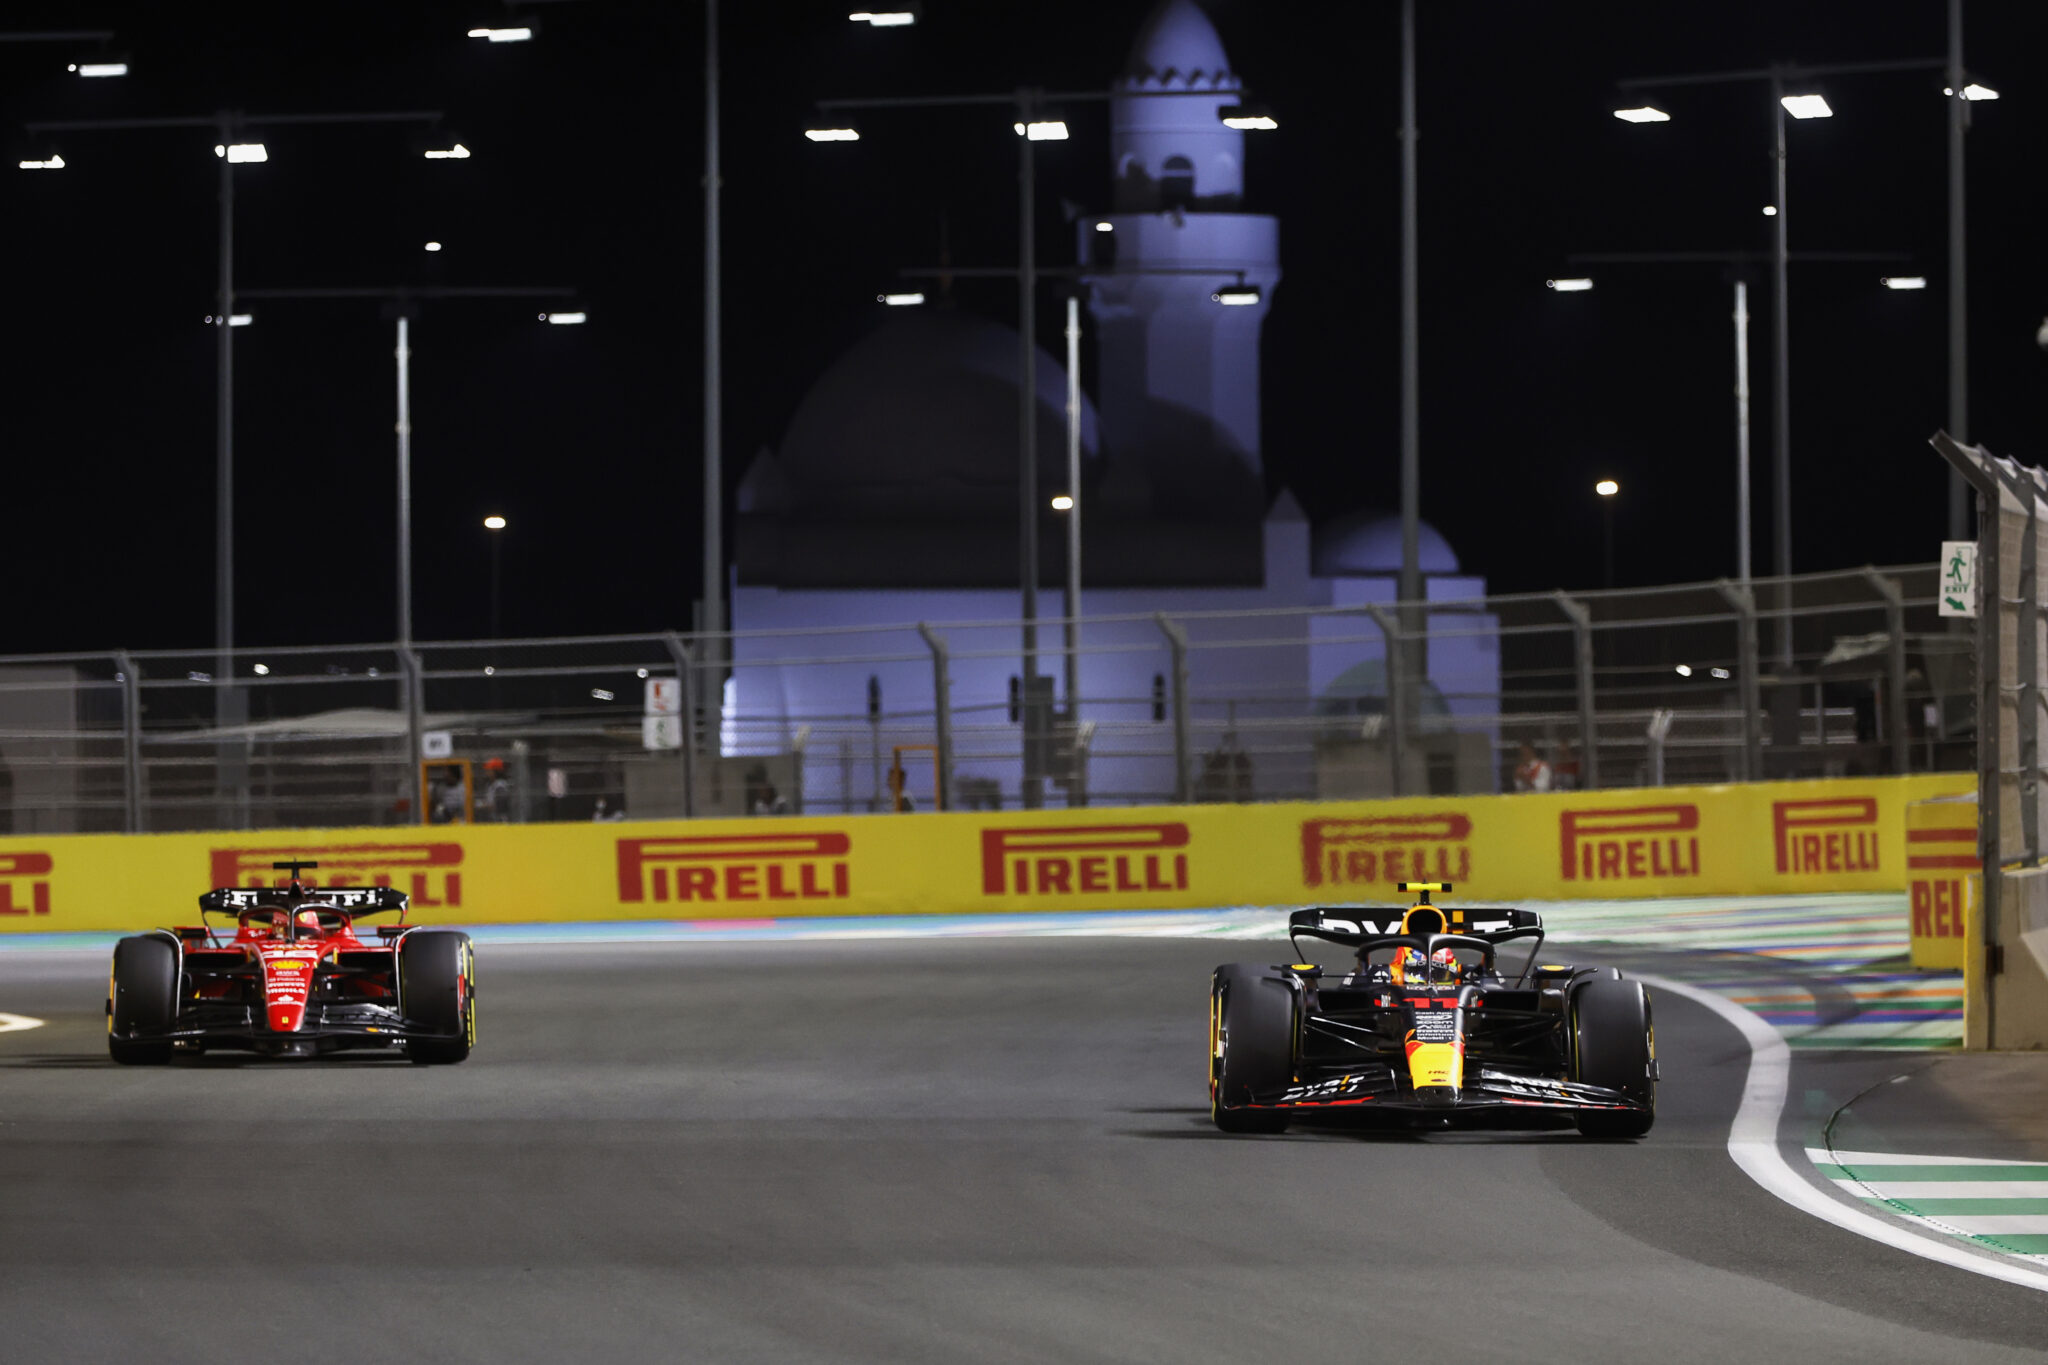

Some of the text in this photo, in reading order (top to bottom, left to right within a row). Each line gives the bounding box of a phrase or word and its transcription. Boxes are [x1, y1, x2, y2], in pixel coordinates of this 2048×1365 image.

[1945, 585, 1968, 593] EXIT
[617, 832, 851, 902] PIRELLI
[981, 822, 1191, 895] PIRELLI
[1300, 813, 1472, 886] PIRELLI
[1561, 803, 1699, 881] PIRELLI
[1773, 797, 1879, 874] PIRELLI
[1402, 997, 1458, 1008] 11
